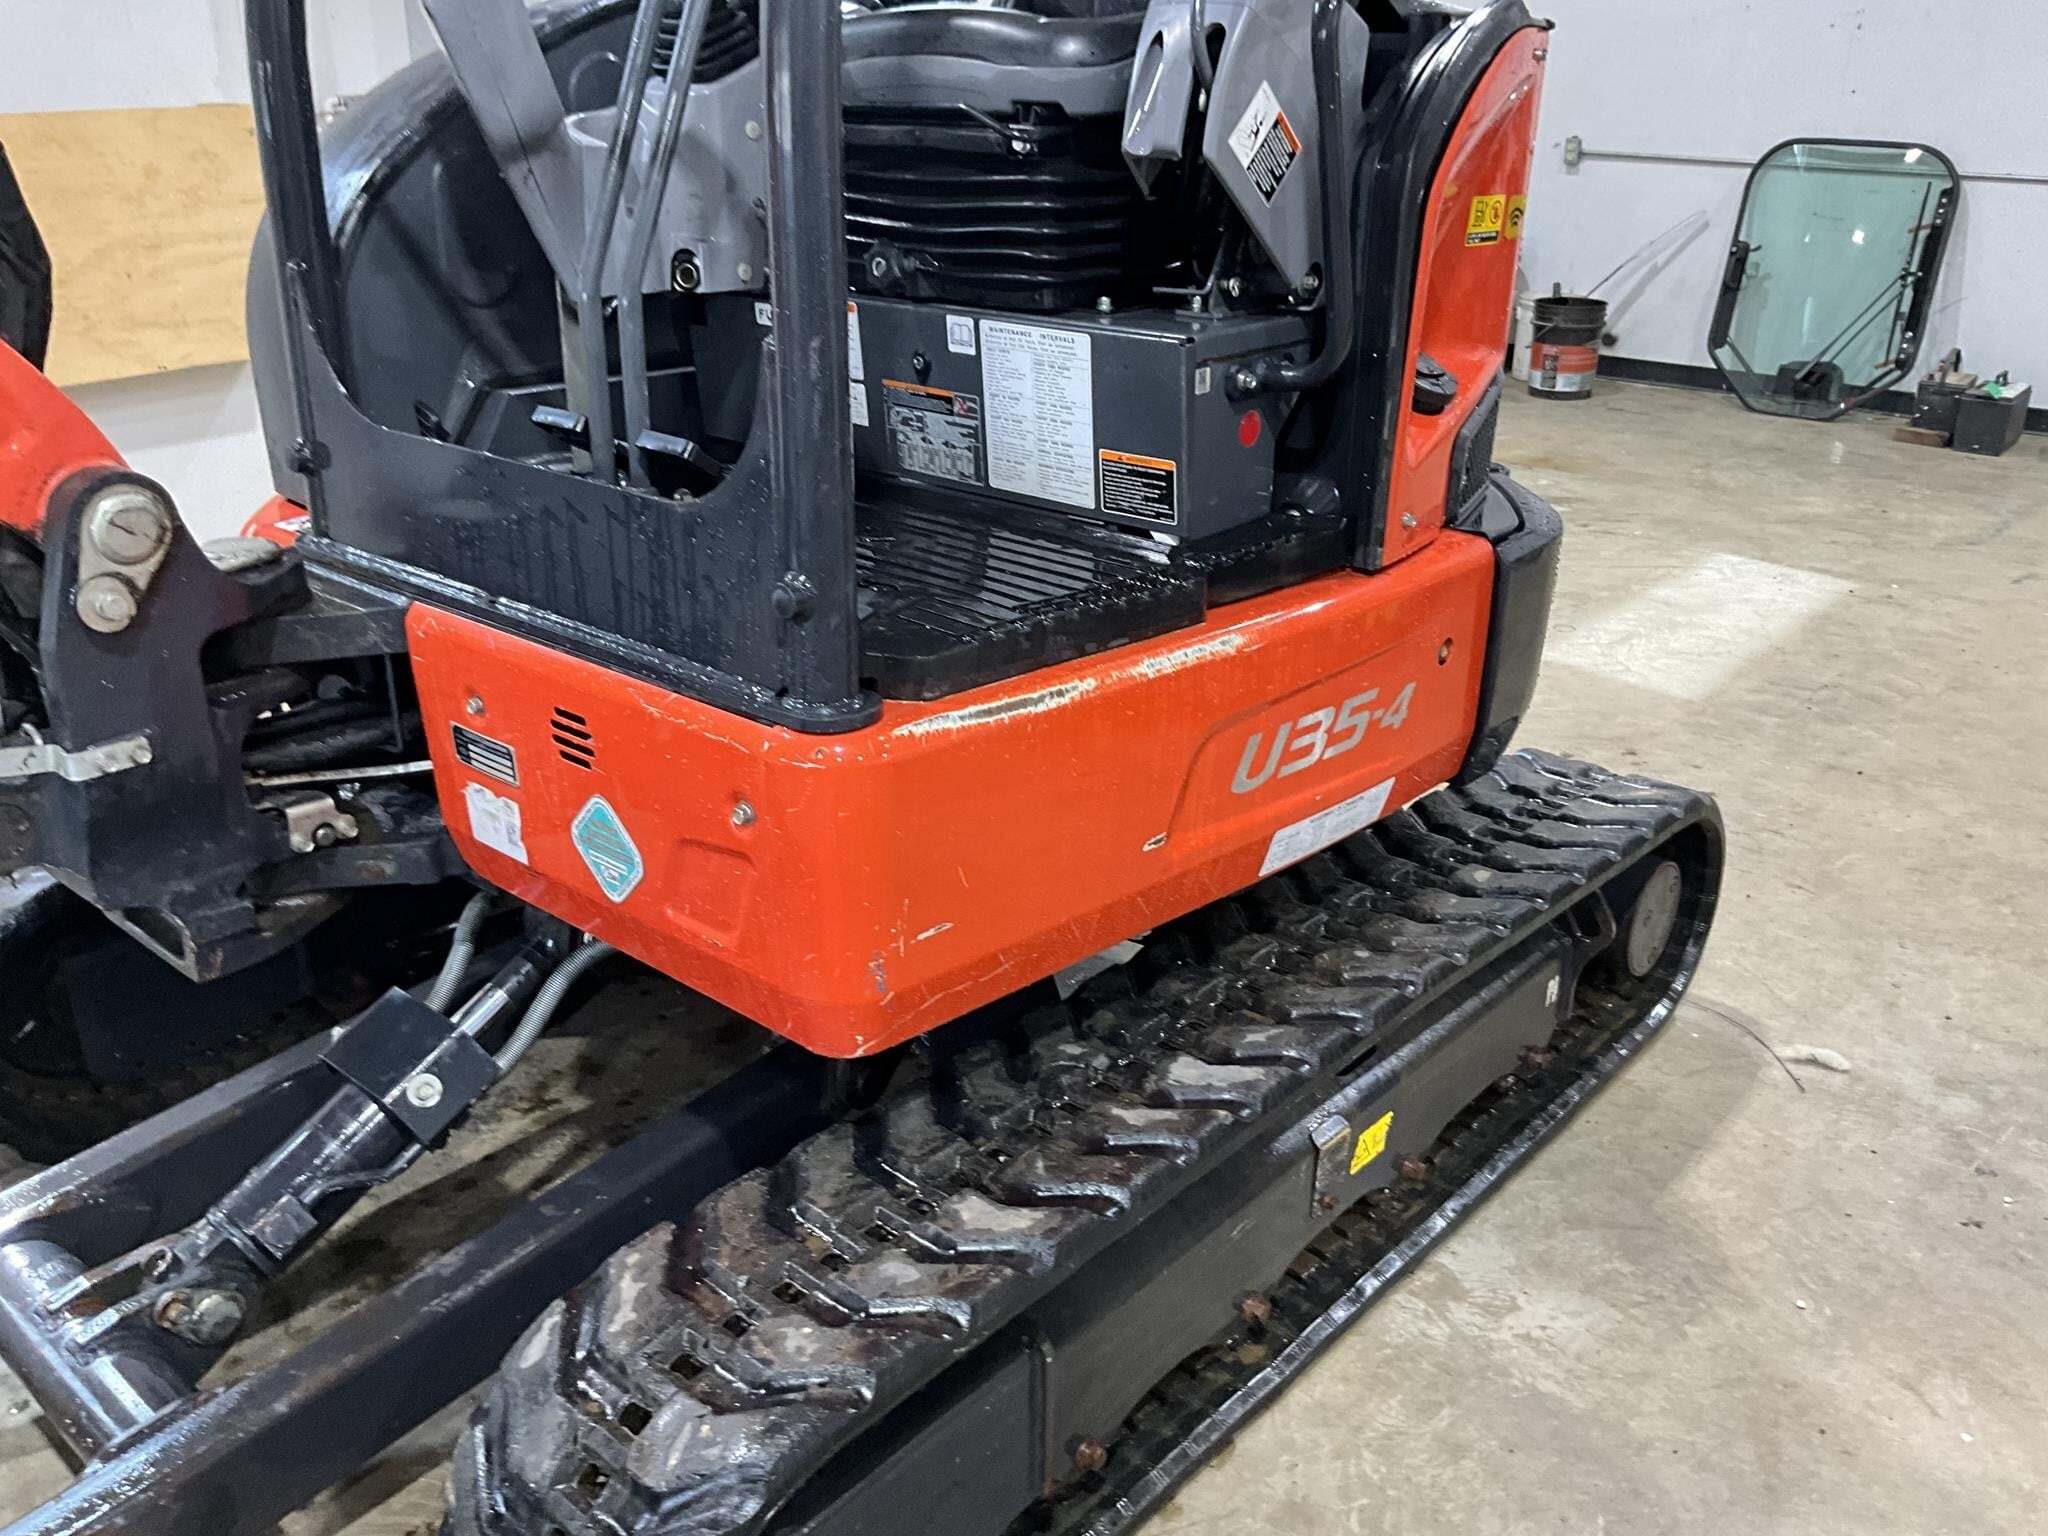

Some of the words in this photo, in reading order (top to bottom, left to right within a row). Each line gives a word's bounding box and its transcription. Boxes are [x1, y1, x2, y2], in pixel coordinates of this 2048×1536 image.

[988, 326, 1032, 338] MAINTENANCE
[1039, 333, 1075, 344] INTERVALS
[1231, 681, 1417, 794] U35-4
